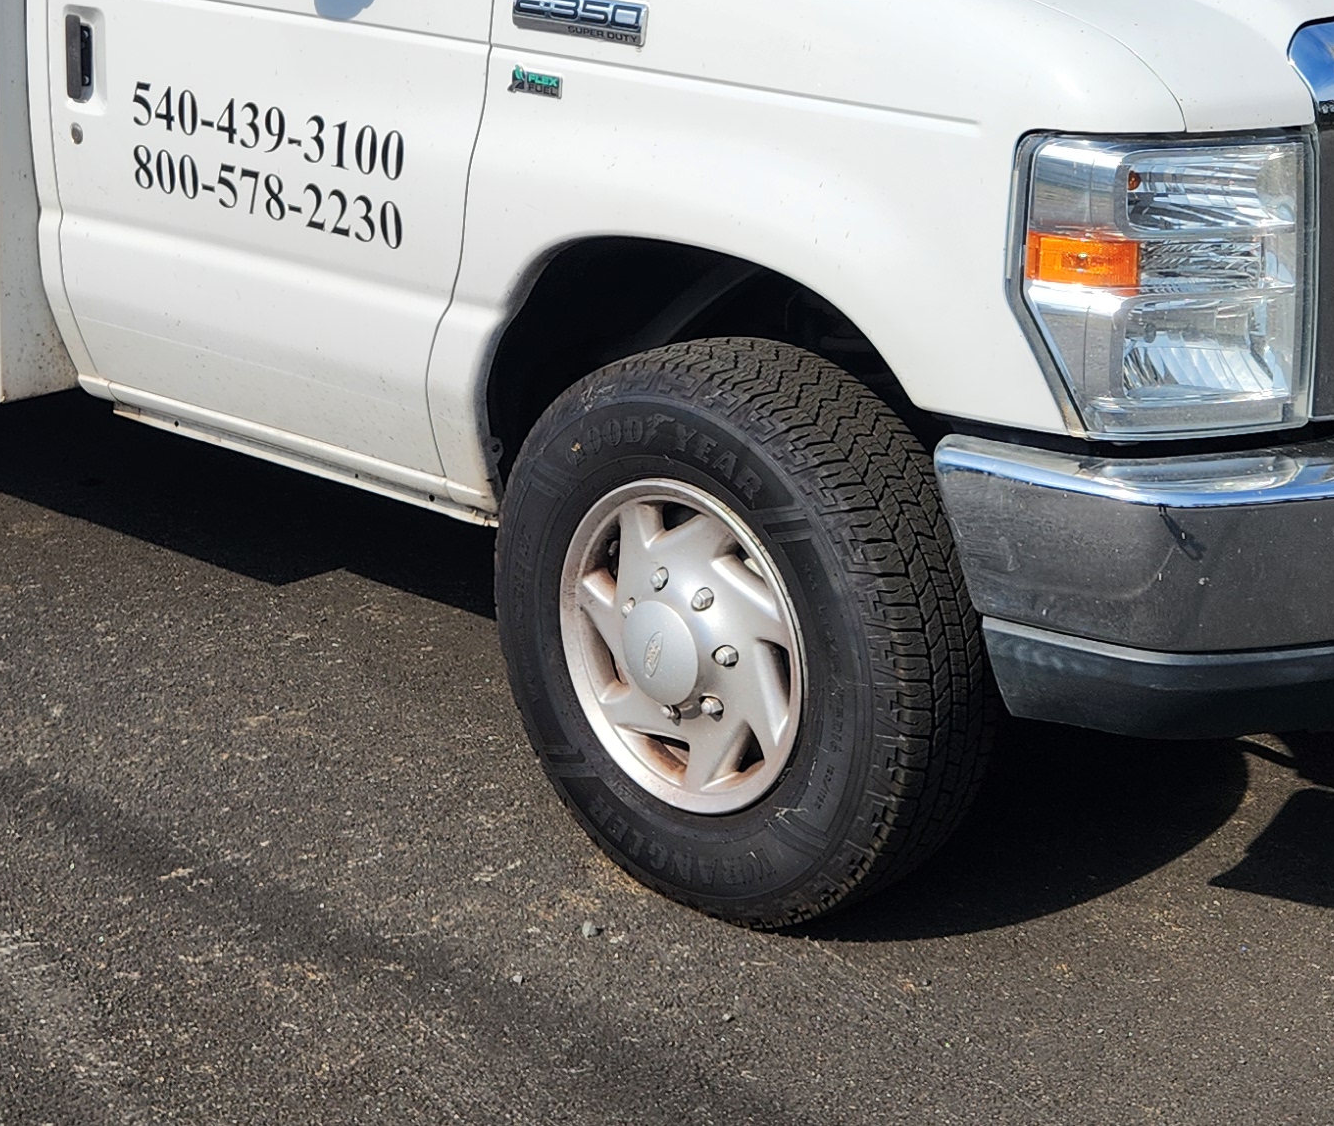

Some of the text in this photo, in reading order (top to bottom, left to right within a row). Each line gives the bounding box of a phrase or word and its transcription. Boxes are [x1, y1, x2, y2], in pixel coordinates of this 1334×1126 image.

[567, 25, 639, 43] SUPER DUTY
[527, 73, 558, 87] FLEX
[528, 84, 557, 97] FUEL
[132, 81, 405, 181] 540-439-3100
[133, 144, 403, 250] 800-578-2230
